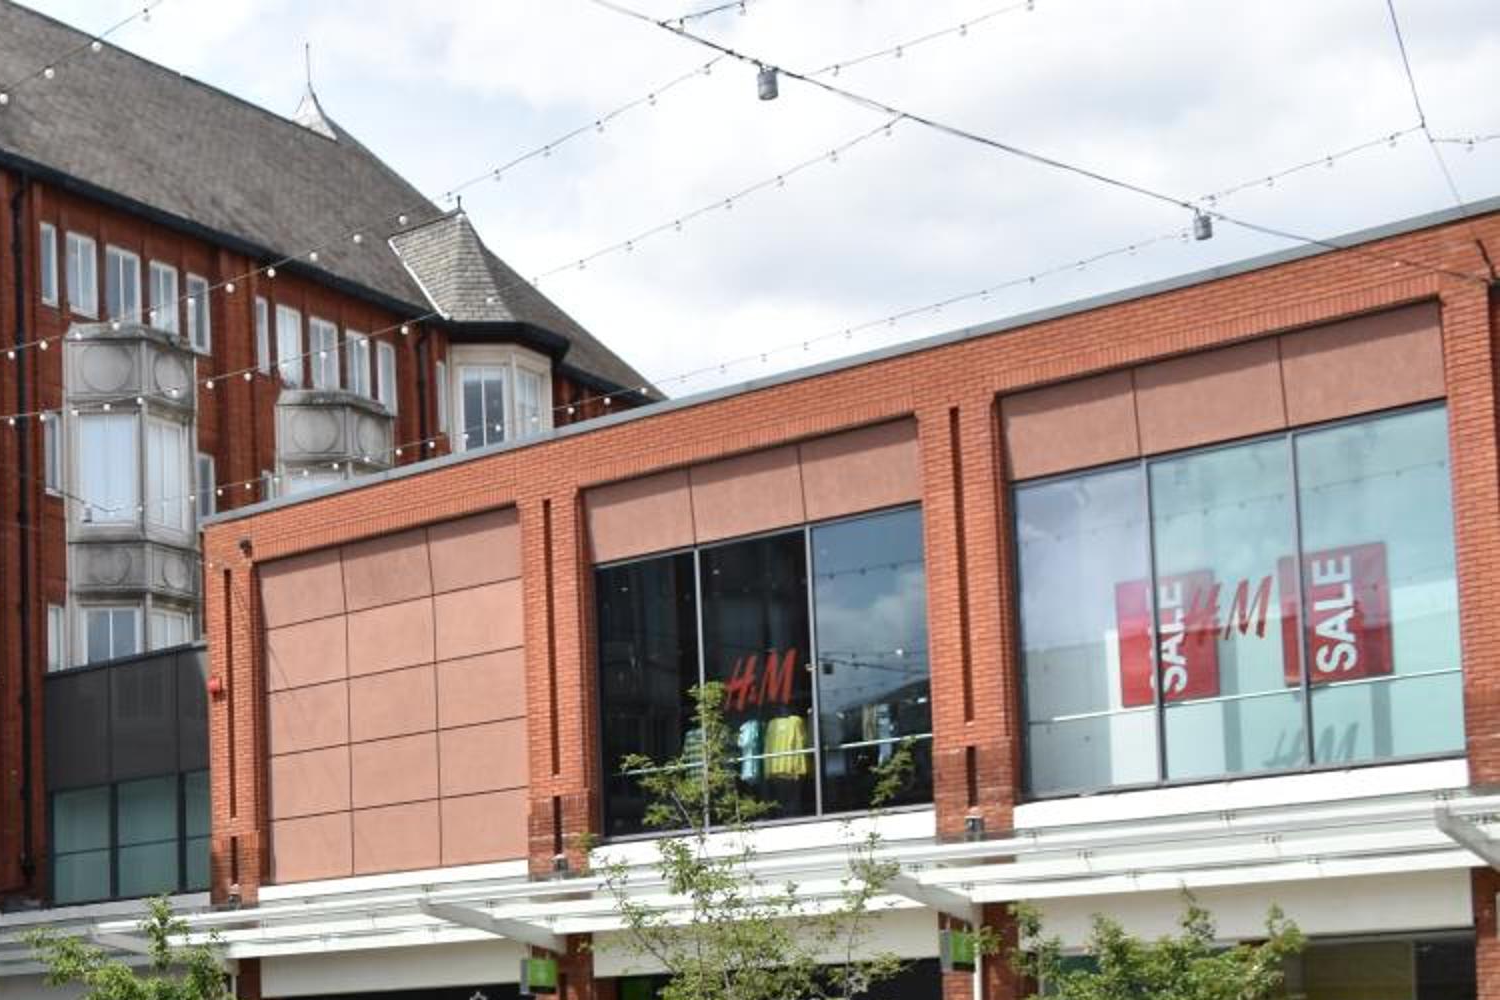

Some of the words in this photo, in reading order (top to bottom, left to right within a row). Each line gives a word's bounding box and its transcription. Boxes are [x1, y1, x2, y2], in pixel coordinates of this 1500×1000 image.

[1148, 580, 1188, 694] SALE
[1184, 576, 1273, 646] HM
[1311, 554, 1358, 673] SALE
